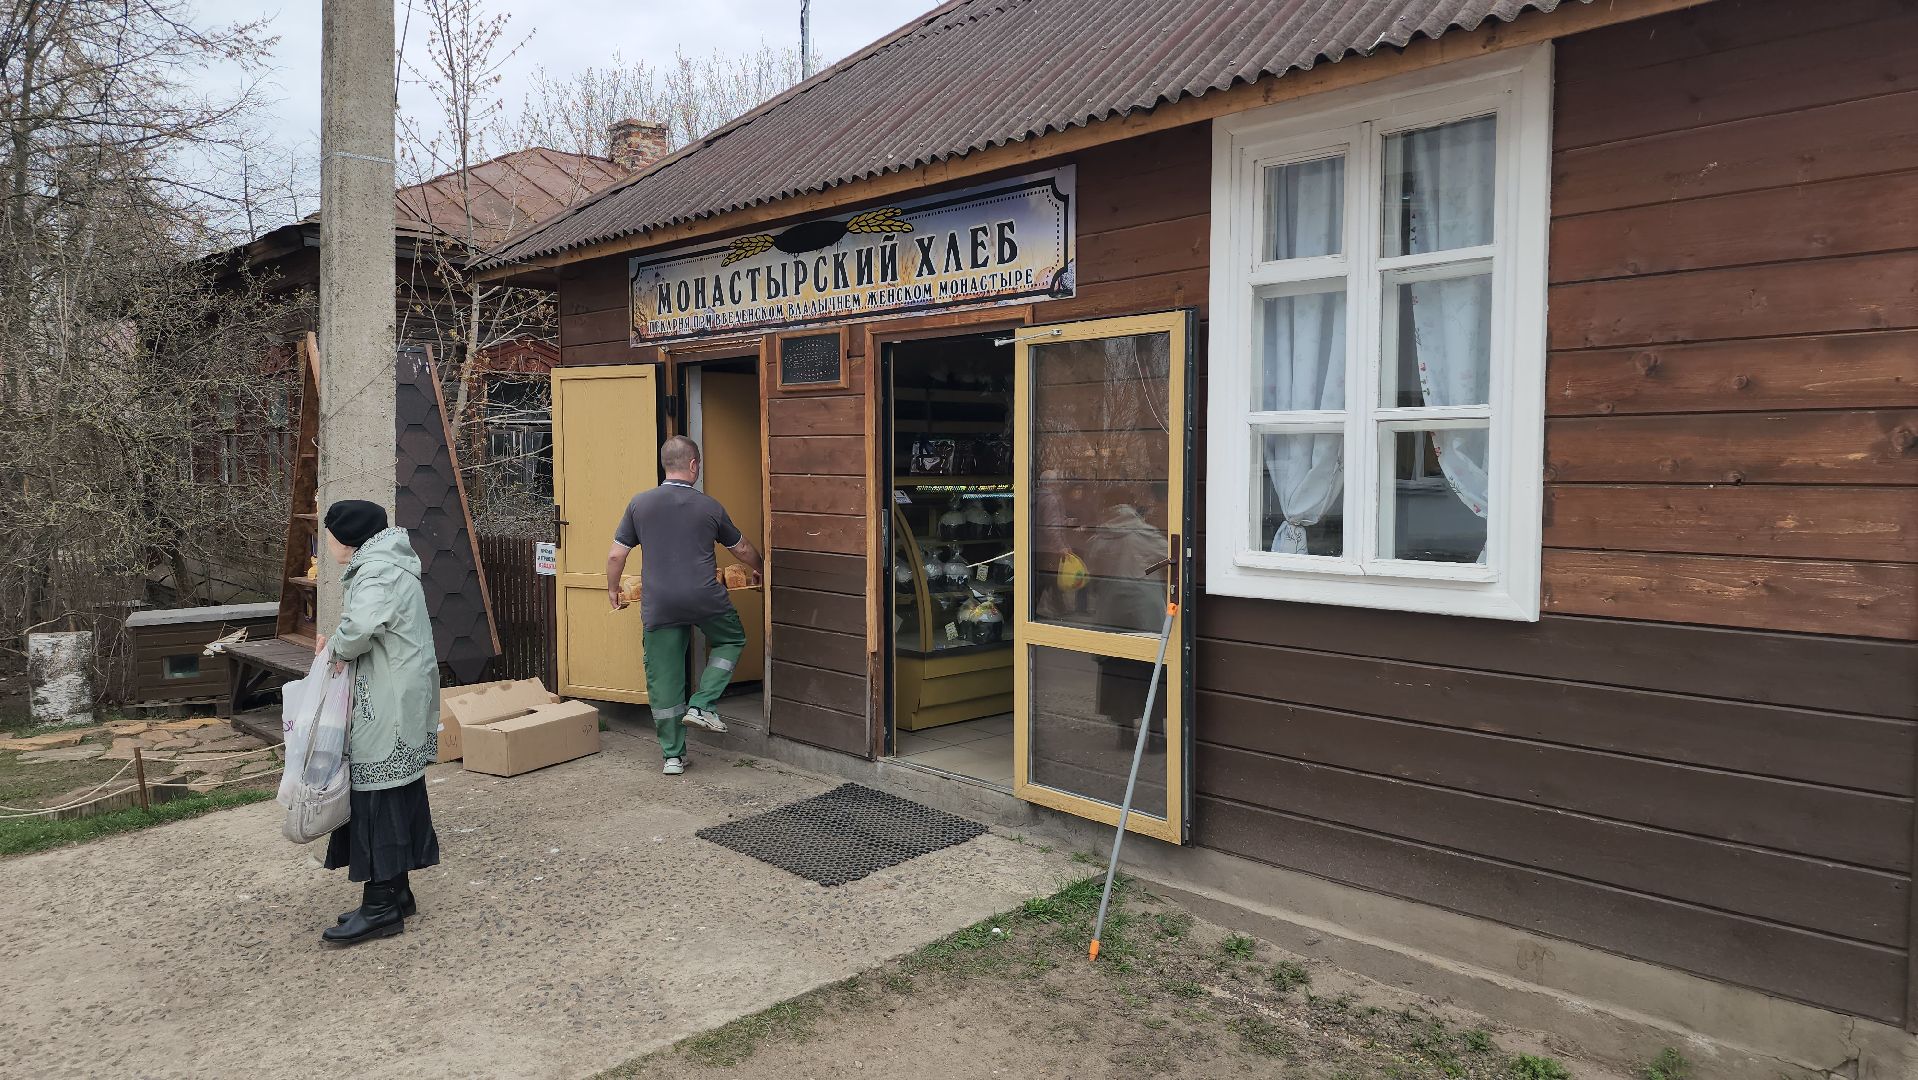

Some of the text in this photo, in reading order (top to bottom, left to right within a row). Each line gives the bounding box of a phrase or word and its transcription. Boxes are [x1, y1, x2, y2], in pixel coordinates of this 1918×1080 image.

[649, 268, 1033, 334] ПЕКАРНЯ ПРИ ВВЕДЕНСКОМ ВЛАДЫЧНЕМ ЖЕНСКОМ МОНАСТЫРЕ
[657, 220, 1018, 316] МОНАСТЫРСКИЙ ХЛЕБ
